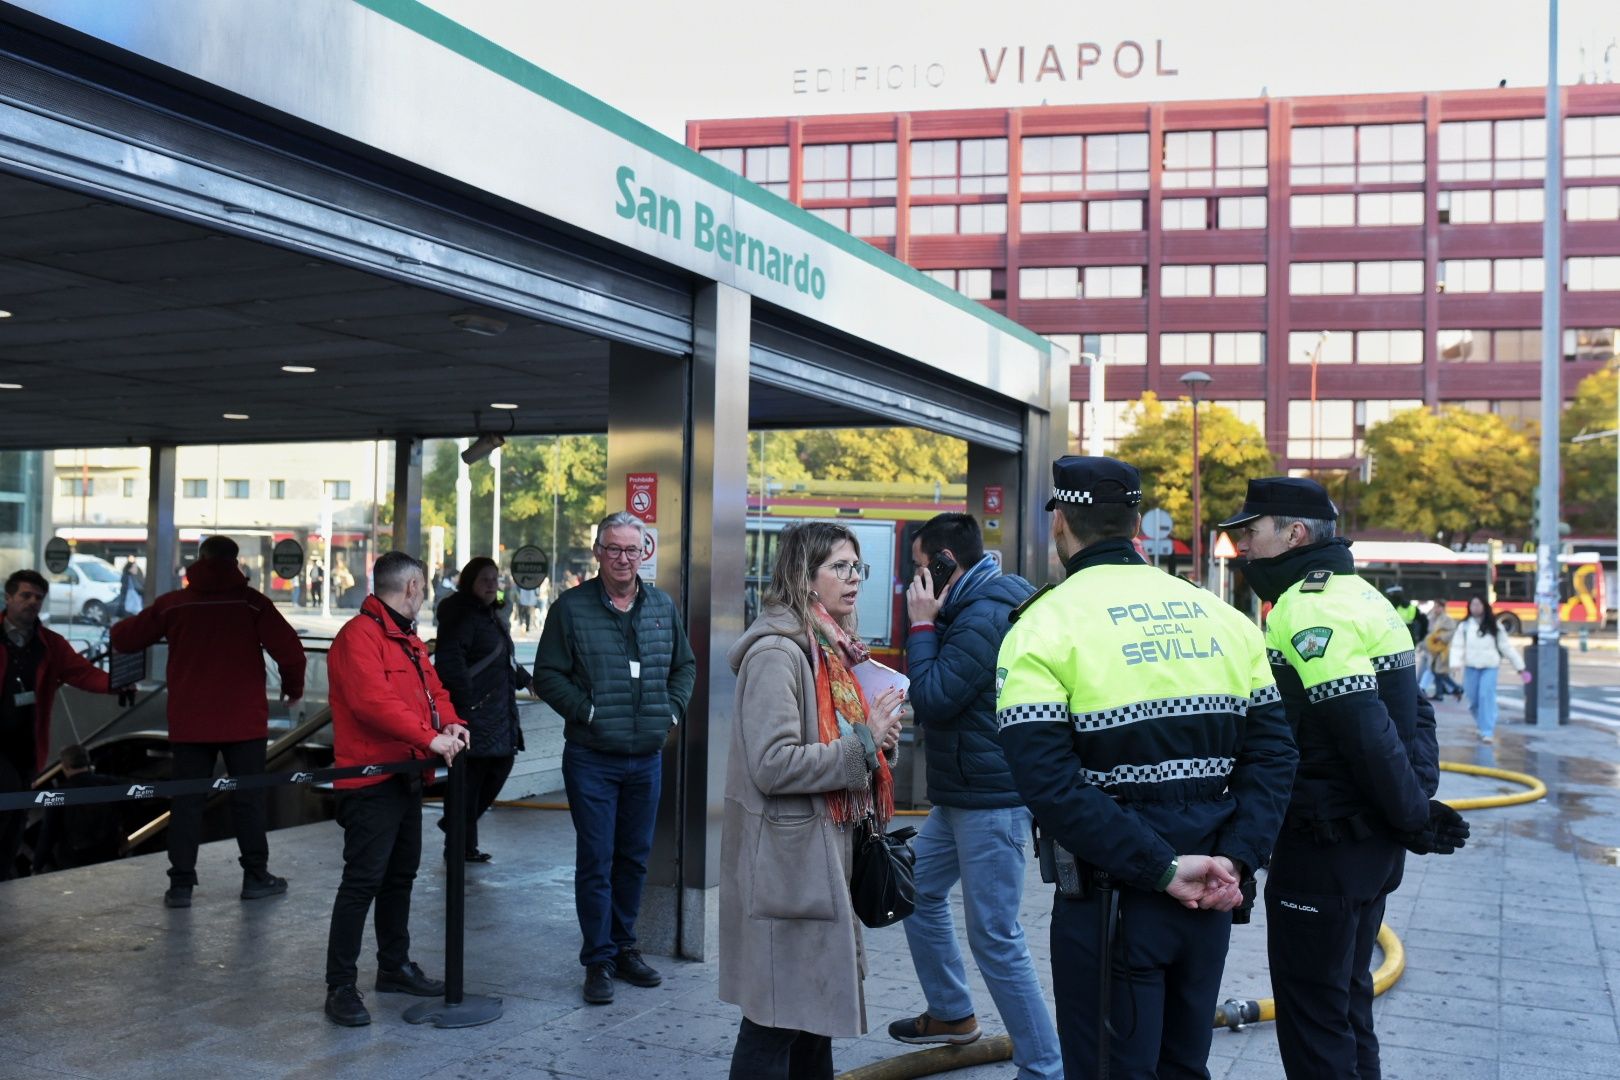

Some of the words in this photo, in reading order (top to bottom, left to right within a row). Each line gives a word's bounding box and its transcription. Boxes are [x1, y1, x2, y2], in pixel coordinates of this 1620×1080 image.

[792, 62, 946, 95] EDIFICIO
[978, 38, 1179, 84] VIAPOL
[615, 165, 682, 241] San
[693, 201, 826, 300] Bernardo
[1107, 601, 1208, 625] POLICIA
[1142, 623, 1193, 636] LOCAL
[1121, 636, 1224, 665] SEVILLA
[1298, 904, 1319, 913] LOCAL
